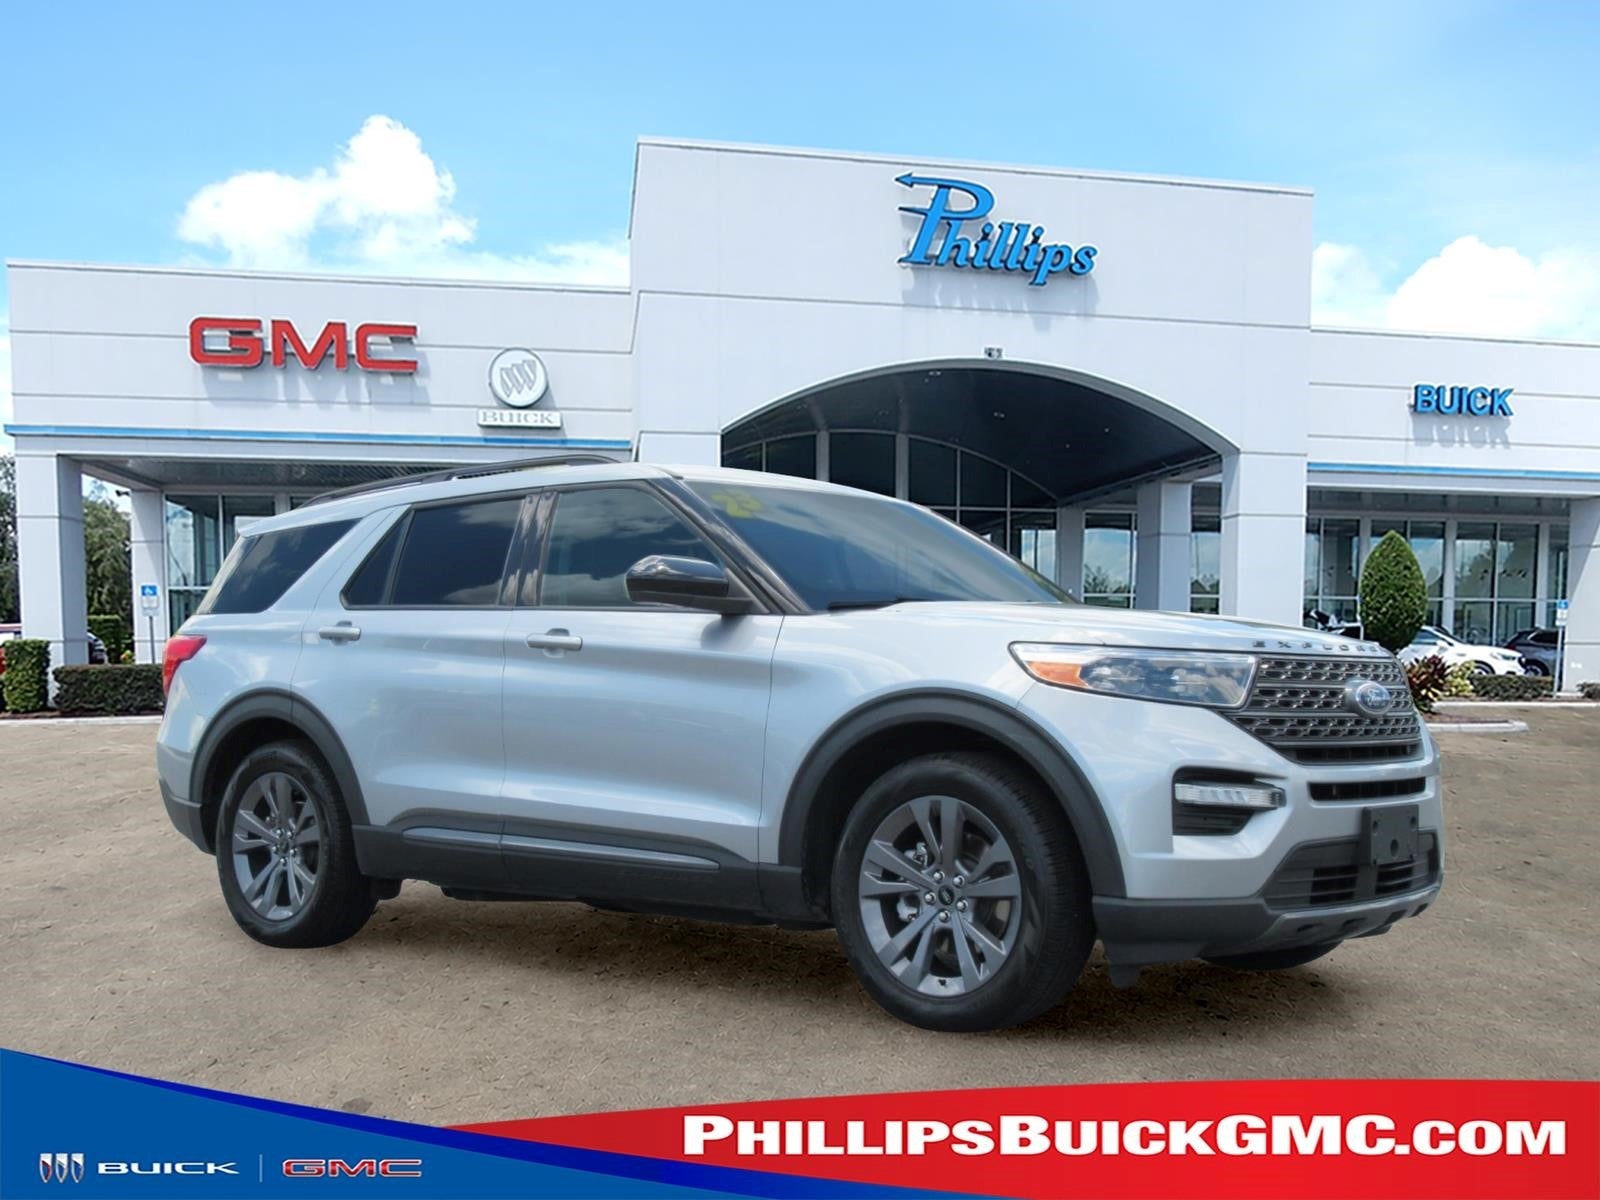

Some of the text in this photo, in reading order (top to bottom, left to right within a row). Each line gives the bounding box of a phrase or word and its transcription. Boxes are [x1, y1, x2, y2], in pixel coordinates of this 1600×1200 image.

[895, 172, 1098, 286] Phillips
[189, 316, 418, 373] GMC
[1414, 384, 1514, 417] BUICK
[482, 411, 555, 424] BUICK
[1252, 640, 1378, 653] EXPLORE
